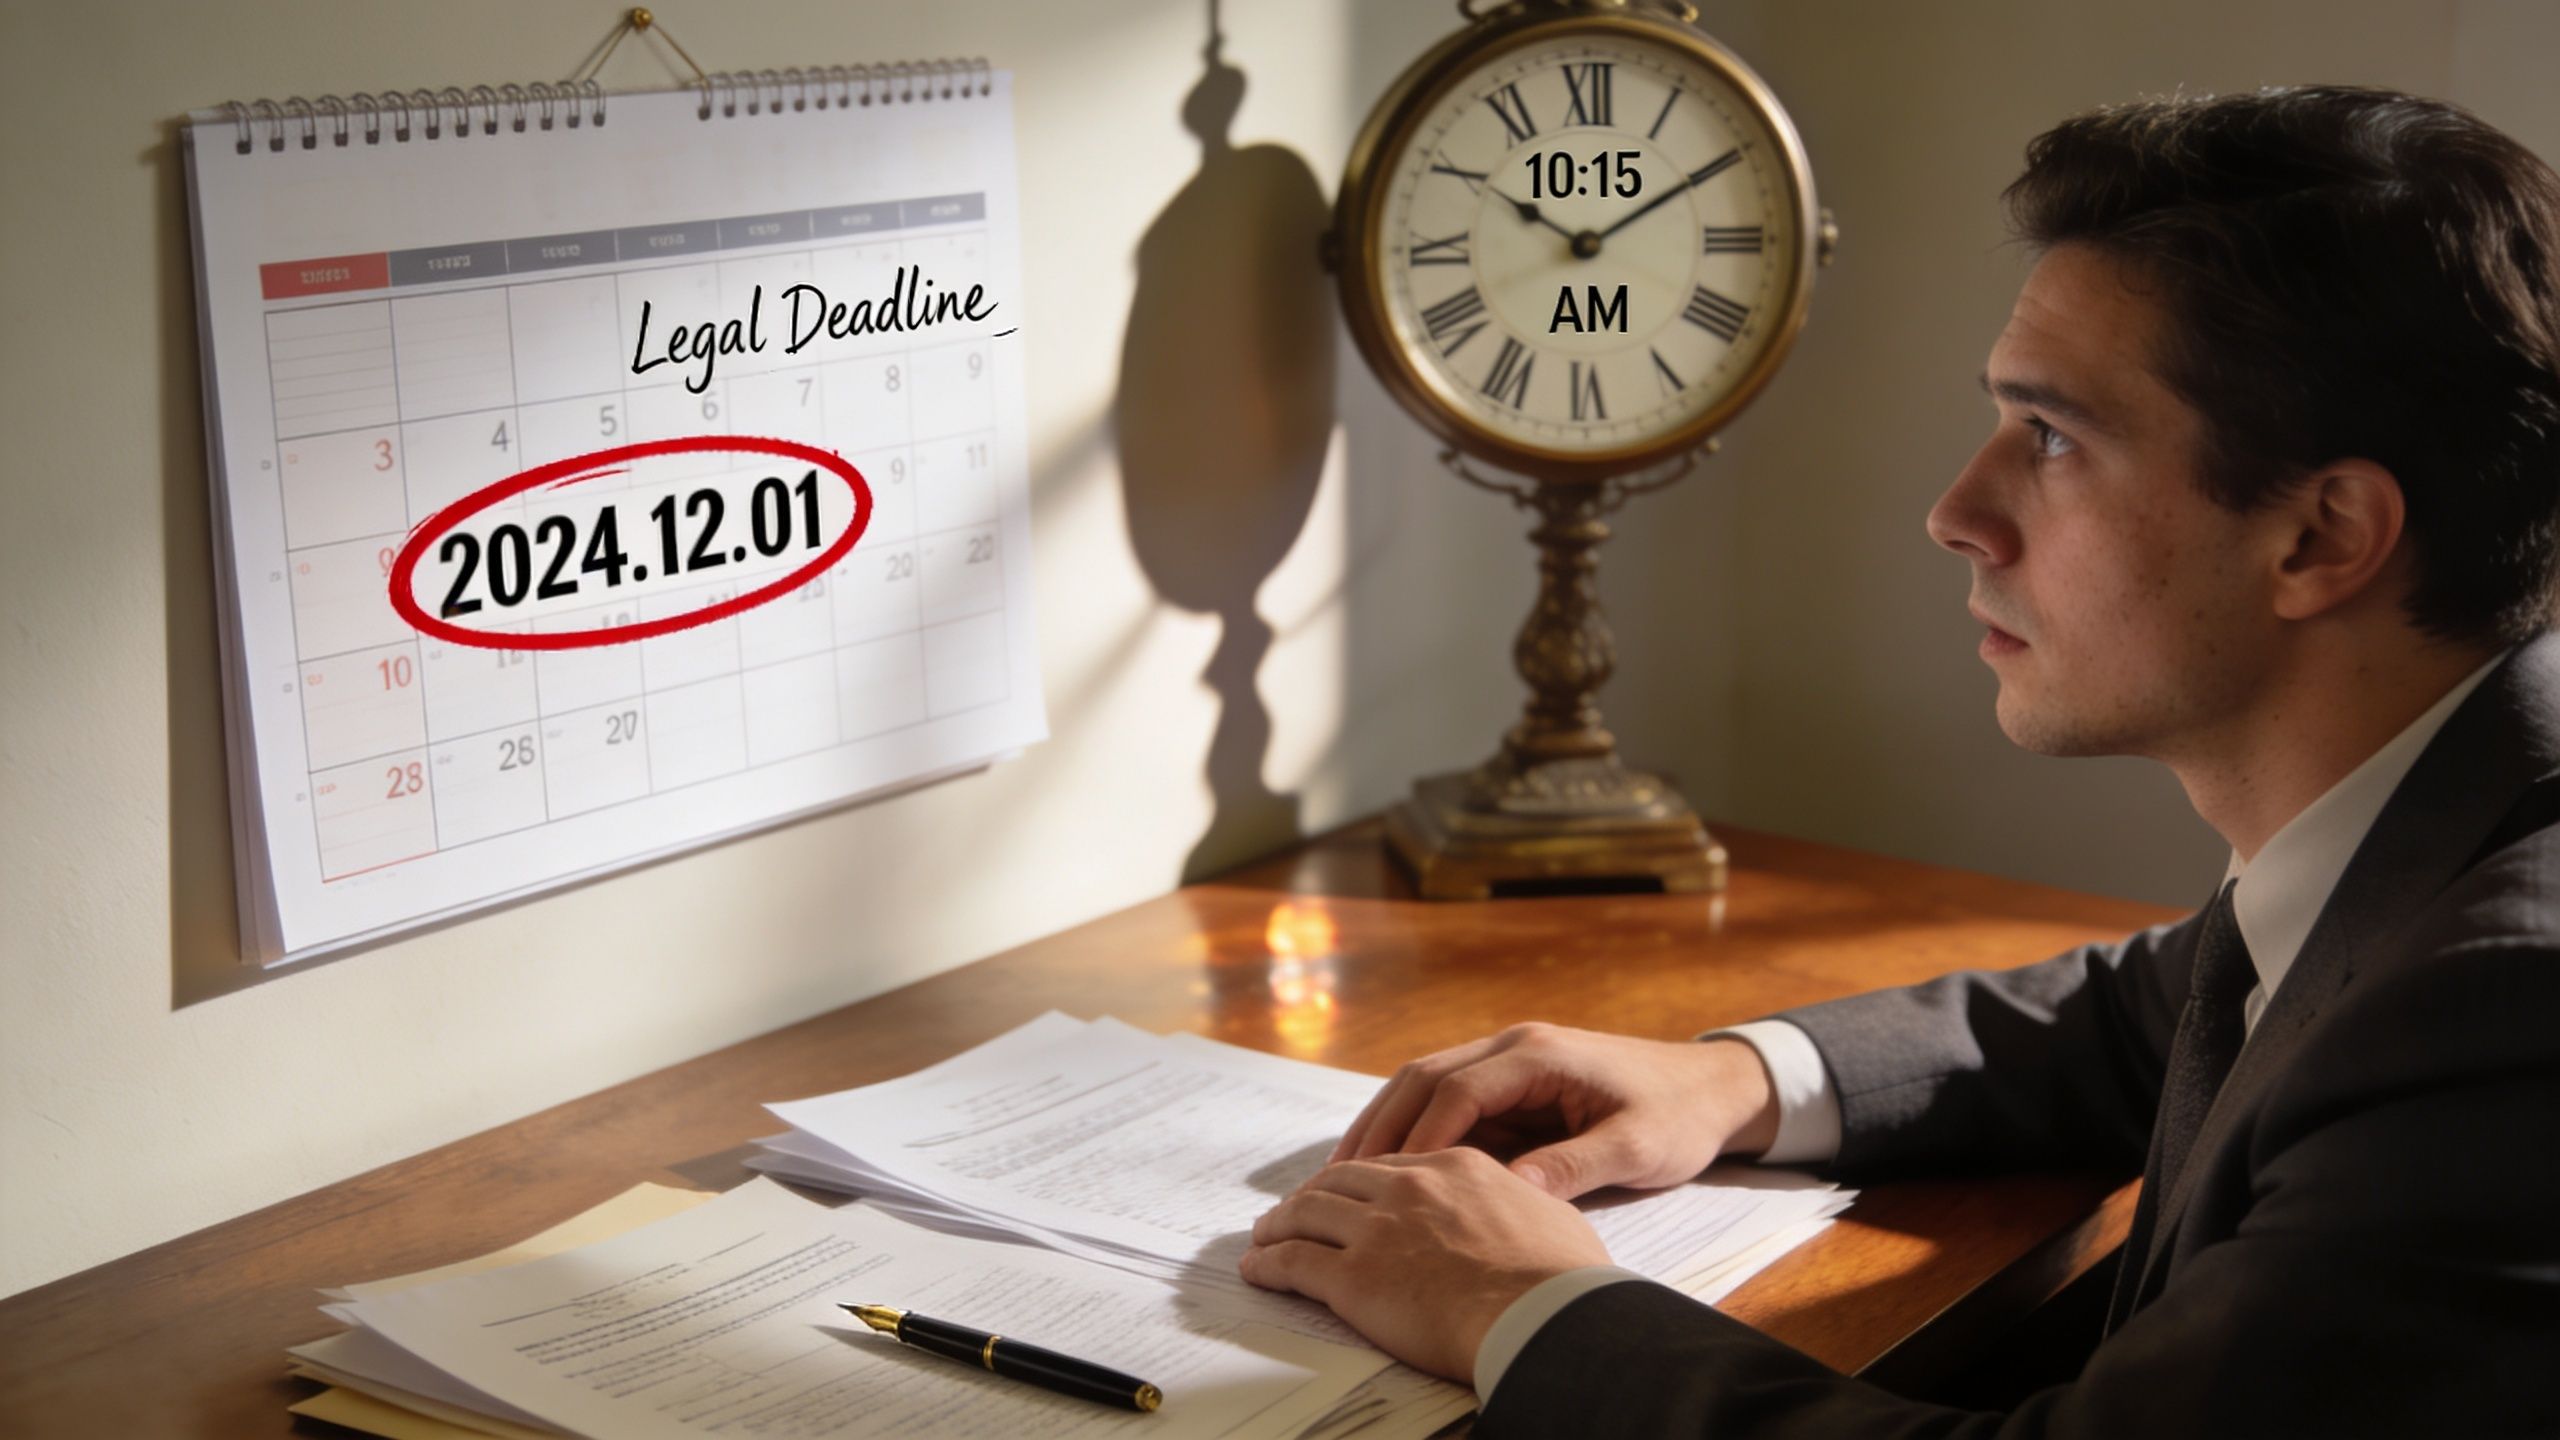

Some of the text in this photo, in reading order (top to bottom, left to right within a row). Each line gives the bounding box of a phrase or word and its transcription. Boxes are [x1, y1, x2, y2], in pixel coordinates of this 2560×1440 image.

[1561, 62, 1616, 127] XII
[1483, 81, 1539, 149] XI
[1524, 150, 1643, 199] 10:15
[1703, 225, 1763, 255] III
[1548, 284, 1630, 334] AM
[631, 264, 999, 394] Legal Deadline
[885, 364, 901, 393] 8
[967, 351, 983, 380] 9
[701, 390, 719, 421] 6
[797, 378, 813, 407] 7
[490, 419, 512, 452] 4
[600, 405, 618, 437] 5
[374, 438, 394, 471] 3
[439, 469, 822, 620] 2024.12.01
[378, 655, 412, 691] 10
[386, 761, 424, 799] 28
